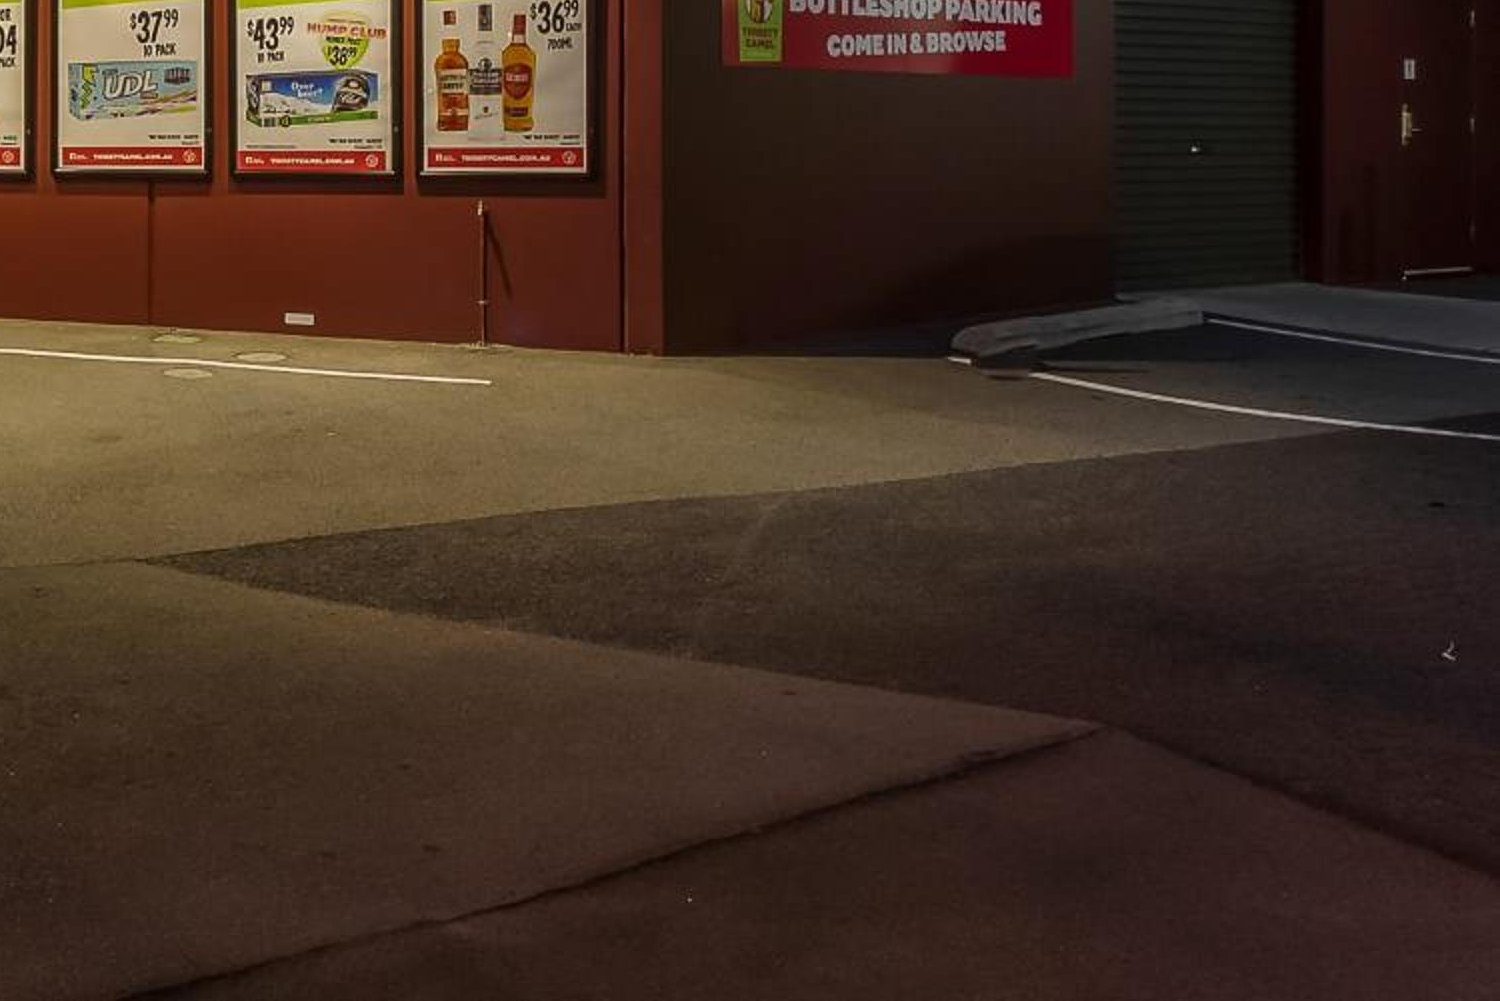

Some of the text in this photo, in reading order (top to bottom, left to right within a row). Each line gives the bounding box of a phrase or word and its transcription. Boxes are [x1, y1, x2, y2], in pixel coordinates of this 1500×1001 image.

[308, 23, 387, 39] HUMP CLUB
[156, 44, 176, 56] PACK
[827, 30, 1006, 57] COME IN & BROWSE
[267, 51, 284, 62] PACK
[103, 70, 158, 99] UDL
